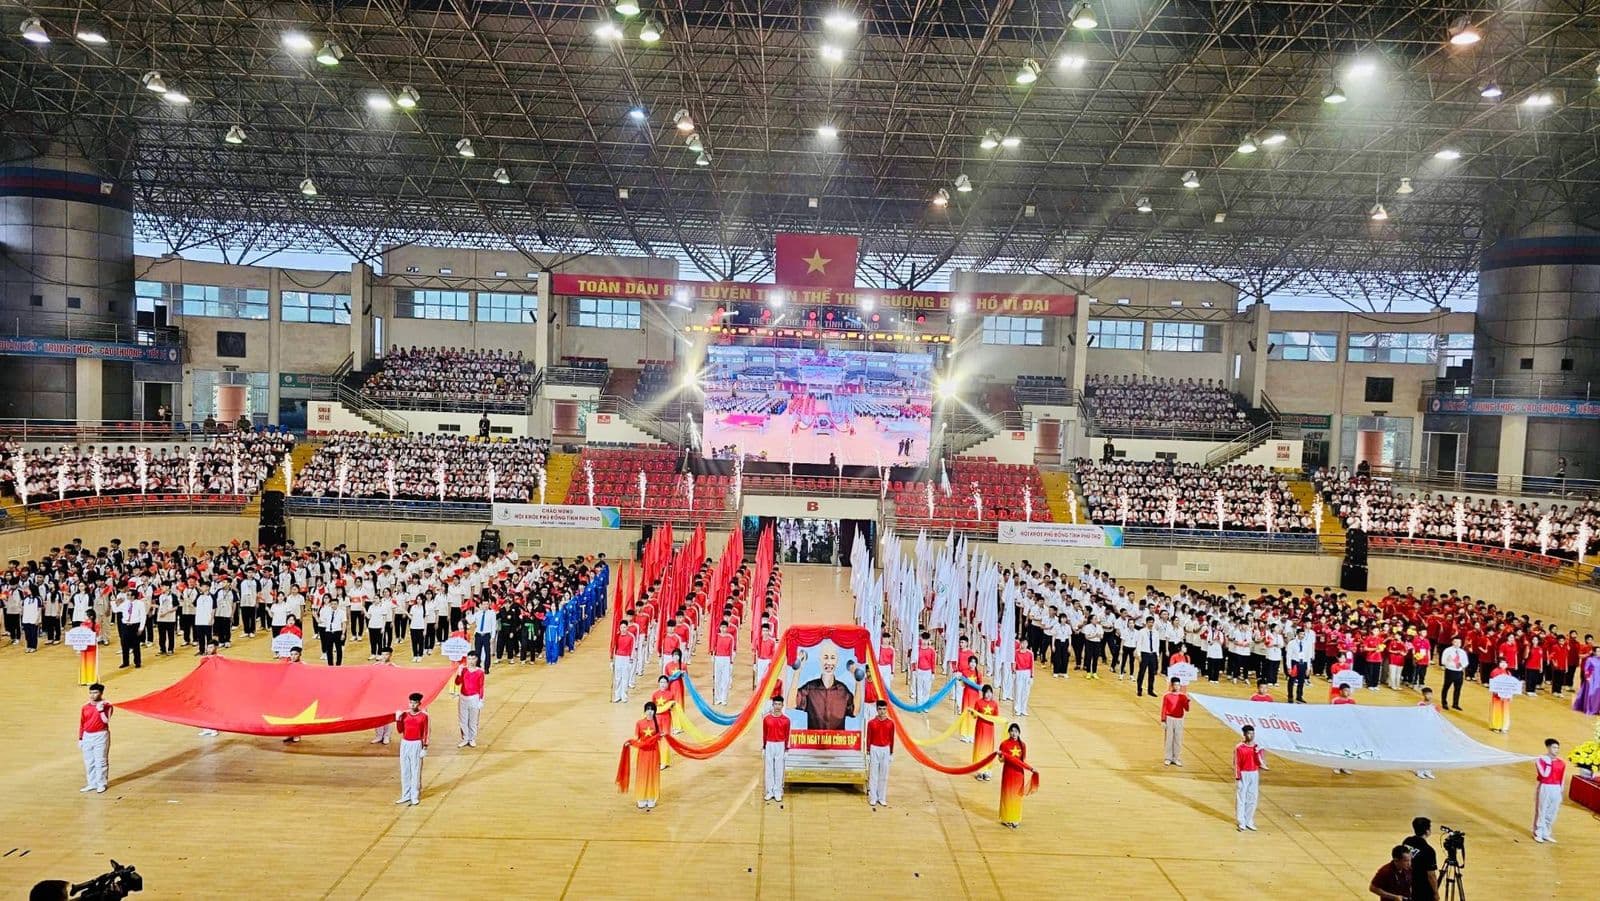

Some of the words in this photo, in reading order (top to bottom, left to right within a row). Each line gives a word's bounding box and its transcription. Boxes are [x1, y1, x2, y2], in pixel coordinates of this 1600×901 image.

[578, 279, 620, 293] TOÀN
[624, 281, 659, 295] DÂN
[1022, 299, 1050, 314] ĐẠI
[807, 502, 818, 511] B
[1258, 713, 1302, 733] ĐỔNG
